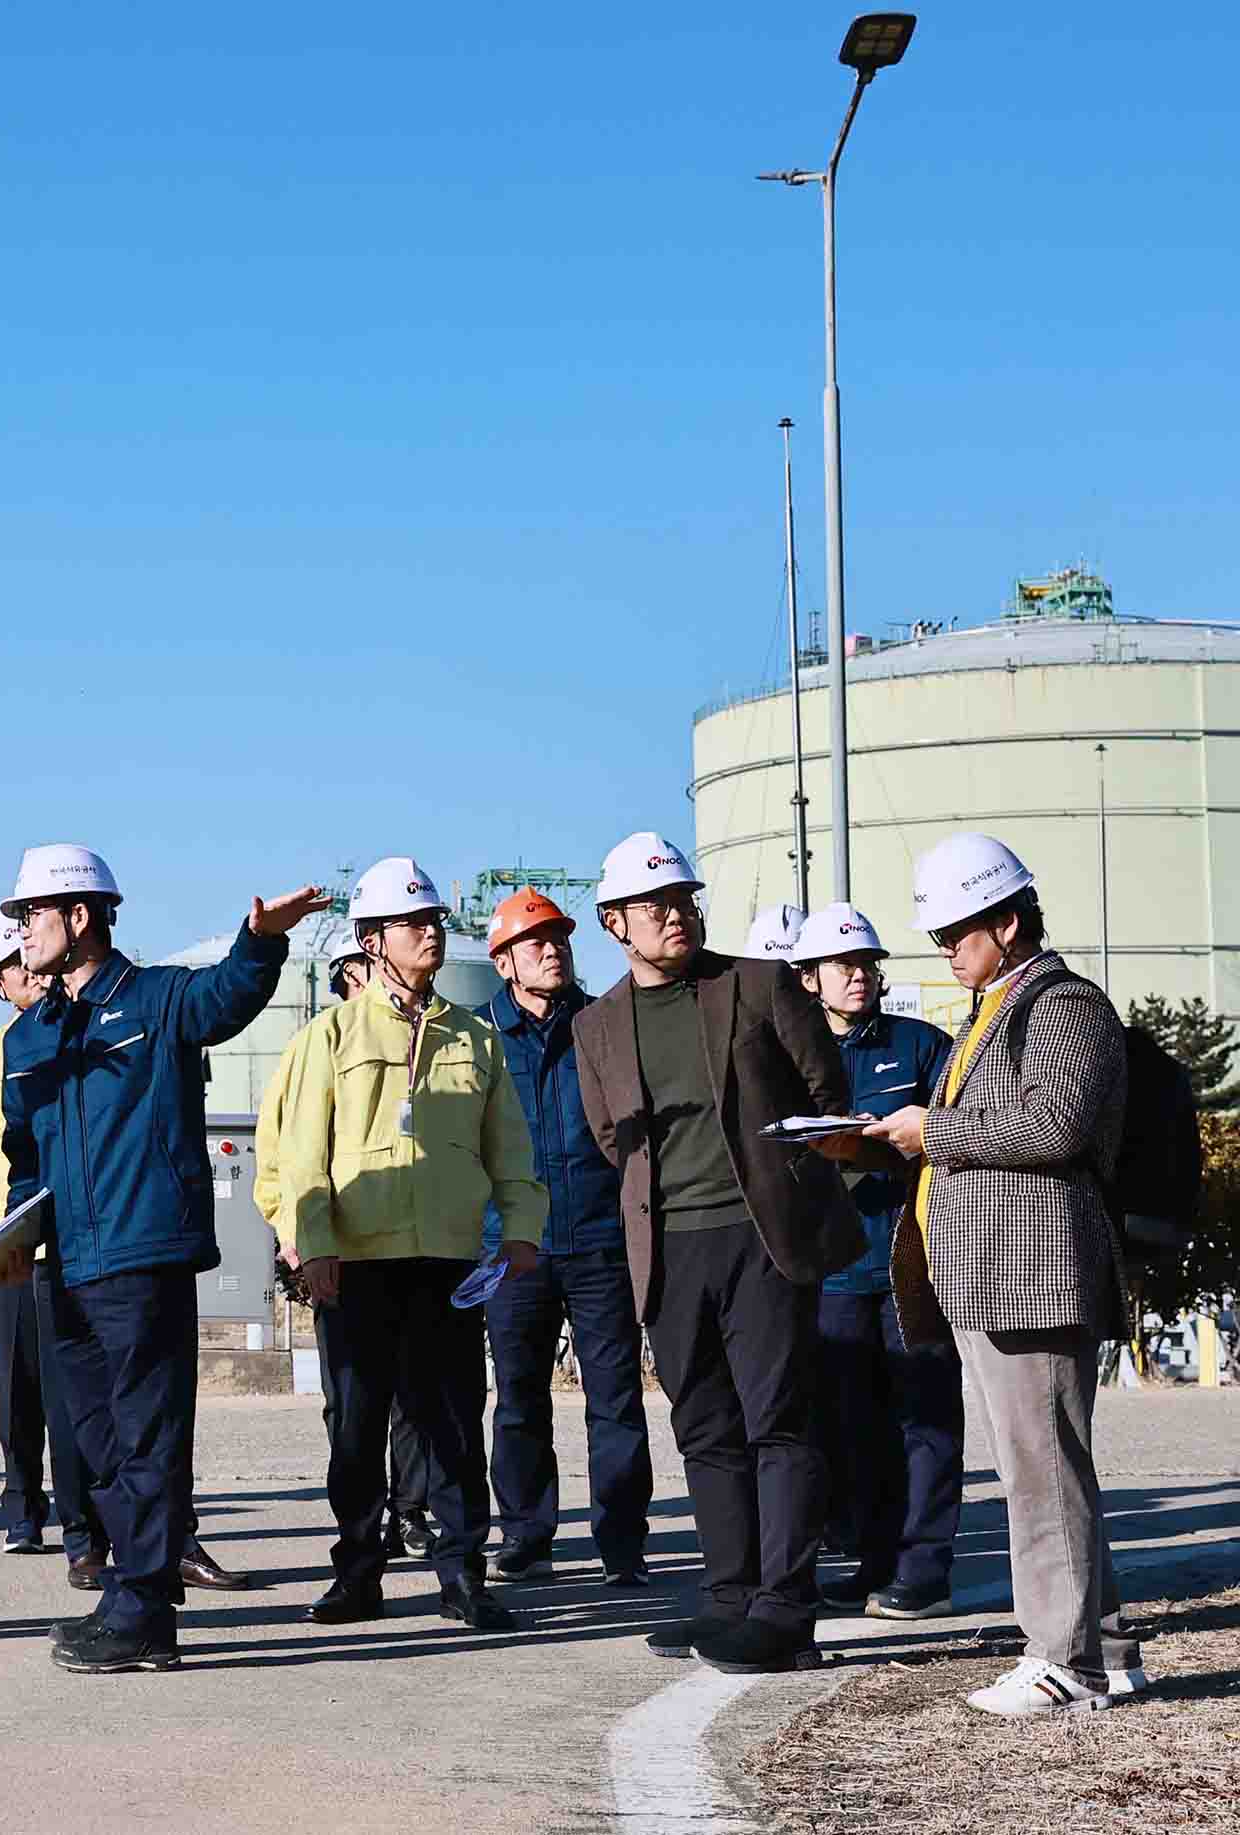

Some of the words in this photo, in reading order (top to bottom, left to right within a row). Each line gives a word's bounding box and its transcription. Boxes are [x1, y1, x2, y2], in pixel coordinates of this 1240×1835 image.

[647, 856, 682, 870] KNOC
[840, 922, 871, 935] KNOC
[764, 940, 795, 952] KNOC
